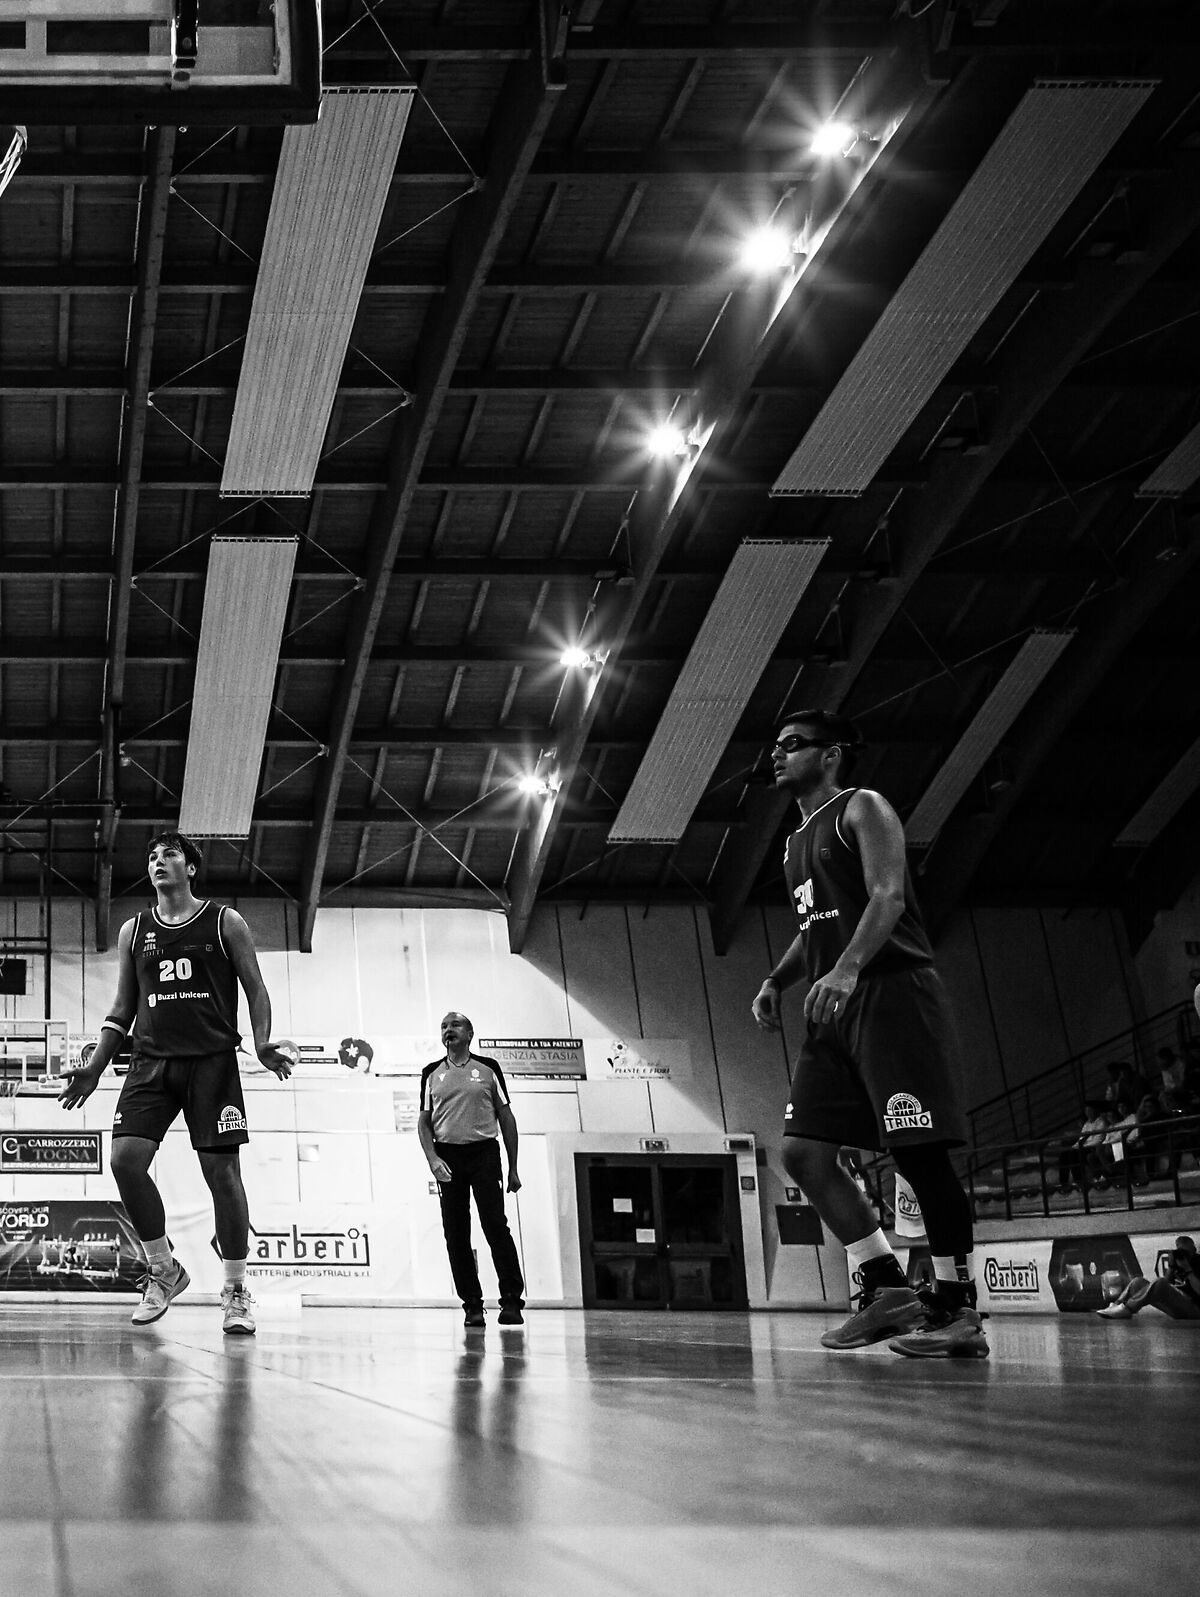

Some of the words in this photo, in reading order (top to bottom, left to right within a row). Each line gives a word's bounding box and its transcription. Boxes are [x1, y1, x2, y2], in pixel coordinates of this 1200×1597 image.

[159, 957, 192, 982] 20
[158, 992, 177, 1000] Buzzi
[180, 991, 209, 999] Unicem
[486, 1051, 537, 1061] AGENZIA
[541, 1051, 578, 1061] STASIA
[886, 1114, 930, 1130] TRINO
[28, 1139, 97, 1148] CARROZZERIA
[32, 1149, 91, 1161] TOGNA
[257, 1224, 360, 1259] arberi
[293, 1269, 351, 1278] INDUSTRIALI
[988, 1260, 1036, 1288] Barberi
